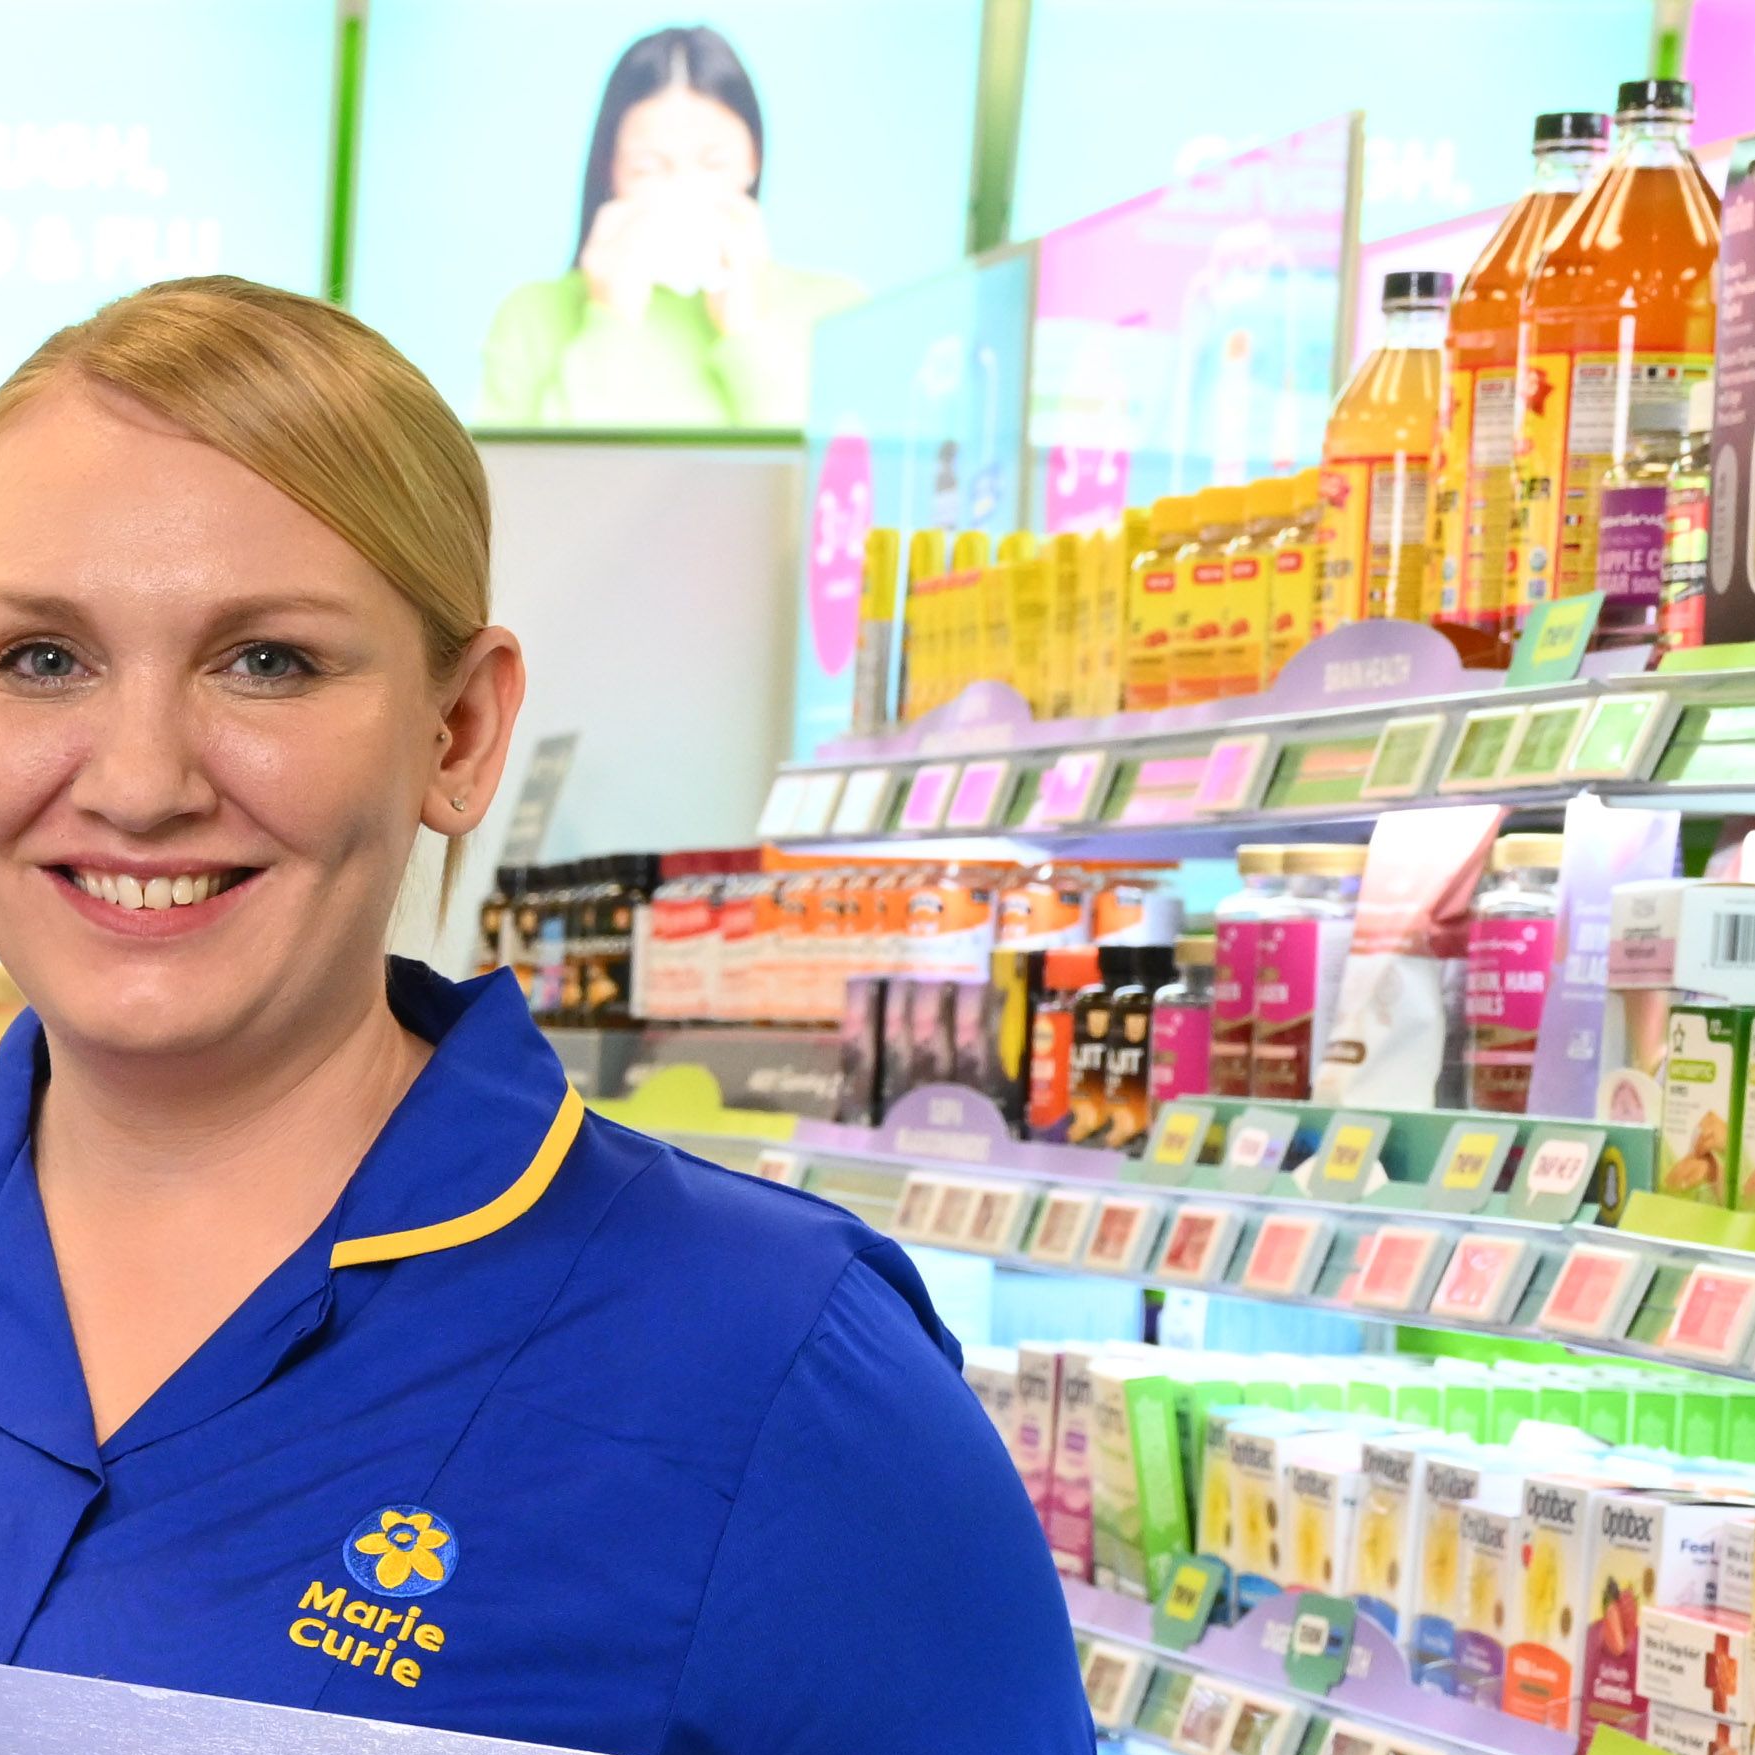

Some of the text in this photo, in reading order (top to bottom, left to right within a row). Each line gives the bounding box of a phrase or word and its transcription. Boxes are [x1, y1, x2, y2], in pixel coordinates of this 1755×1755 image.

[1526, 1485, 1577, 1526] Optibac
[1602, 1504, 1653, 1544] Optibac
[297, 1580, 446, 1653] Marie
[288, 1616, 422, 1689] Curie
